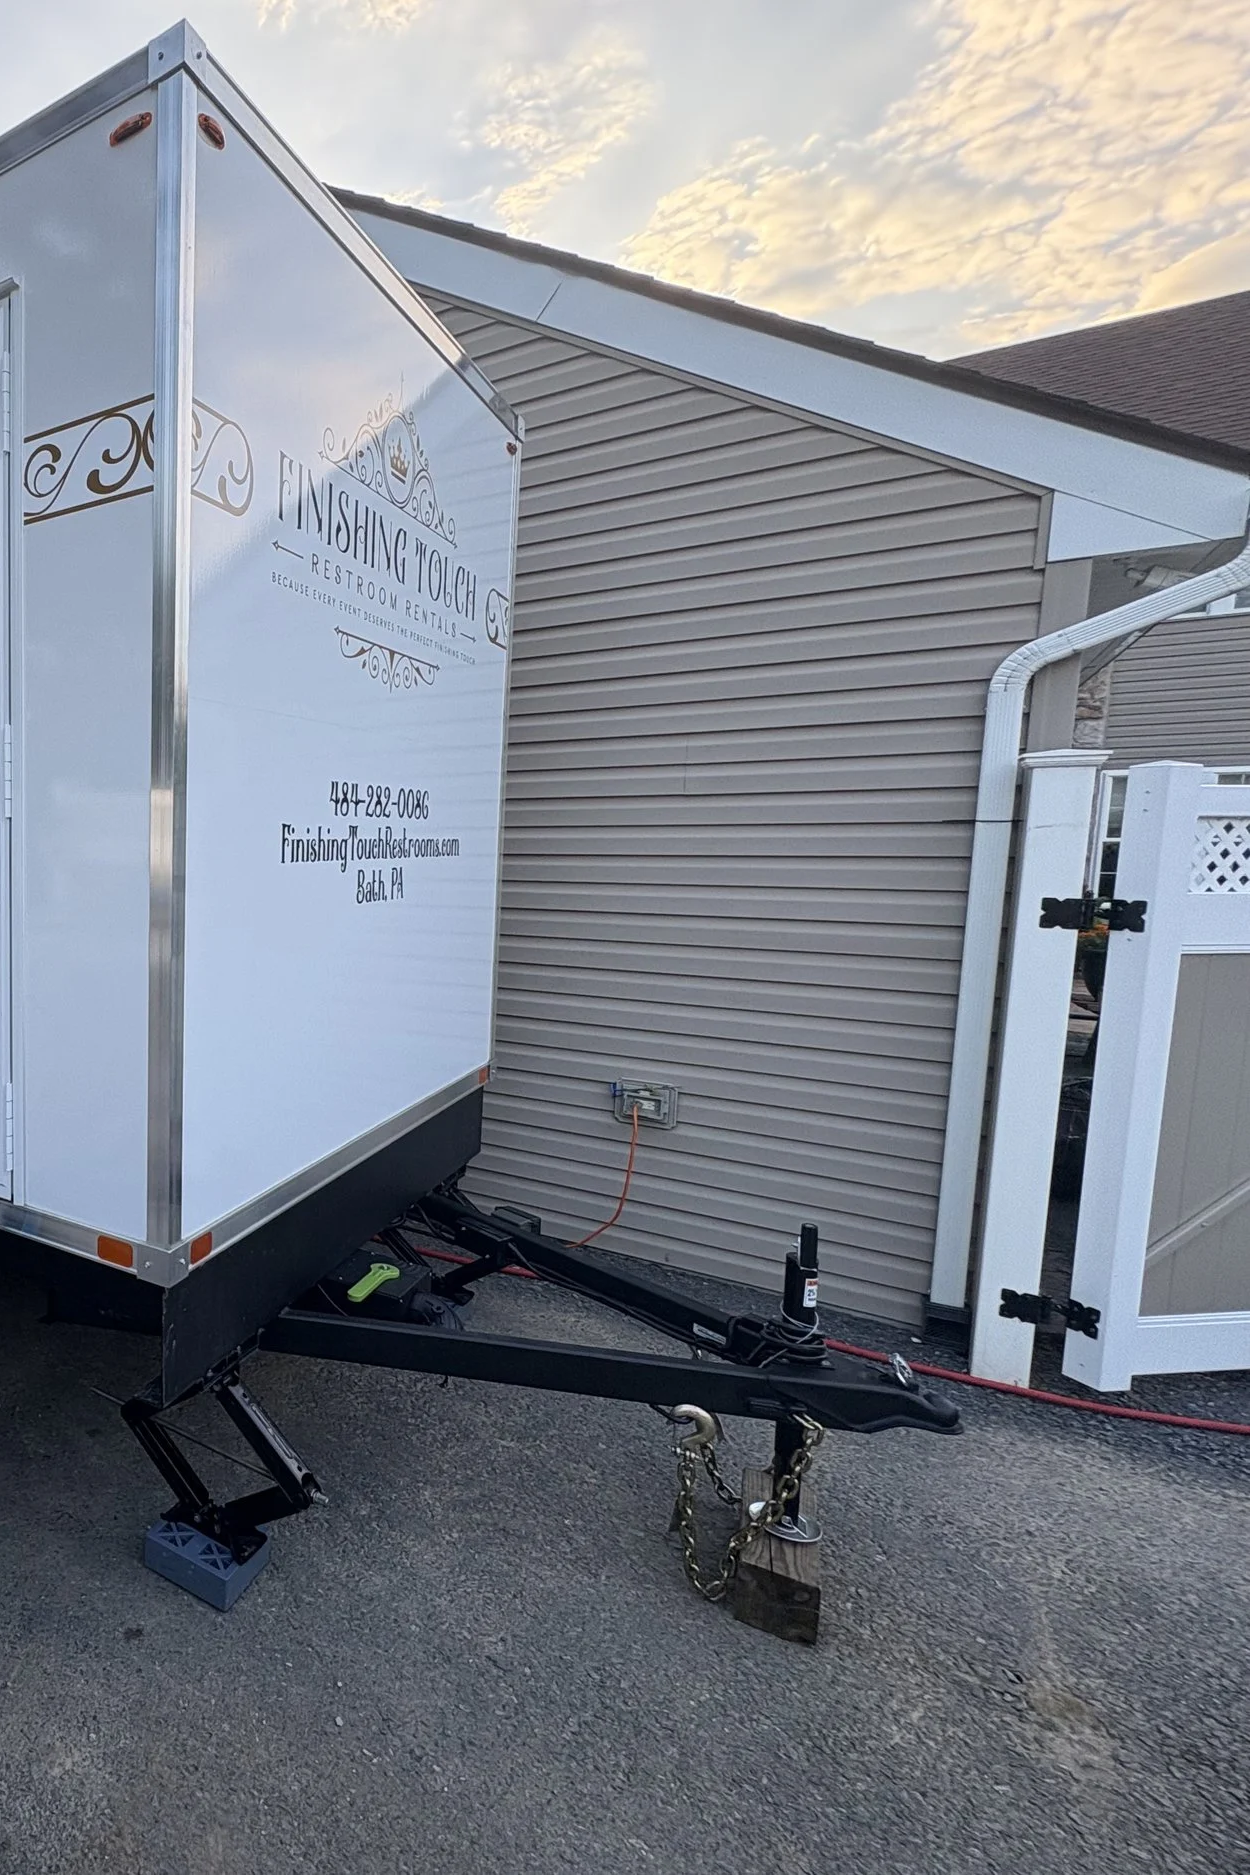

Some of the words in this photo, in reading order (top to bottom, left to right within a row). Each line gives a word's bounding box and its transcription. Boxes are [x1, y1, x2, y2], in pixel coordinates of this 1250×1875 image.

[279, 450, 407, 585] FINISHING
[415, 537, 476, 621] TOUCH
[272, 572, 309, 597] BECAUSE
[313, 589, 336, 607] EVERY
[340, 601, 361, 618] EVENT
[364, 611, 394, 632] DESERVES
[397, 625, 408, 638] THE
[410, 631, 432, 648] PERFECT
[311, 553, 397, 611] RESTROOM
[405, 599, 456, 637] RENTALS
[329, 781, 429, 820] 484-282-0086
[281, 823, 460, 873] FinishingTouchRestrooms.com
[356, 869, 387, 904] Bath,
[391, 866, 404, 900] PA
